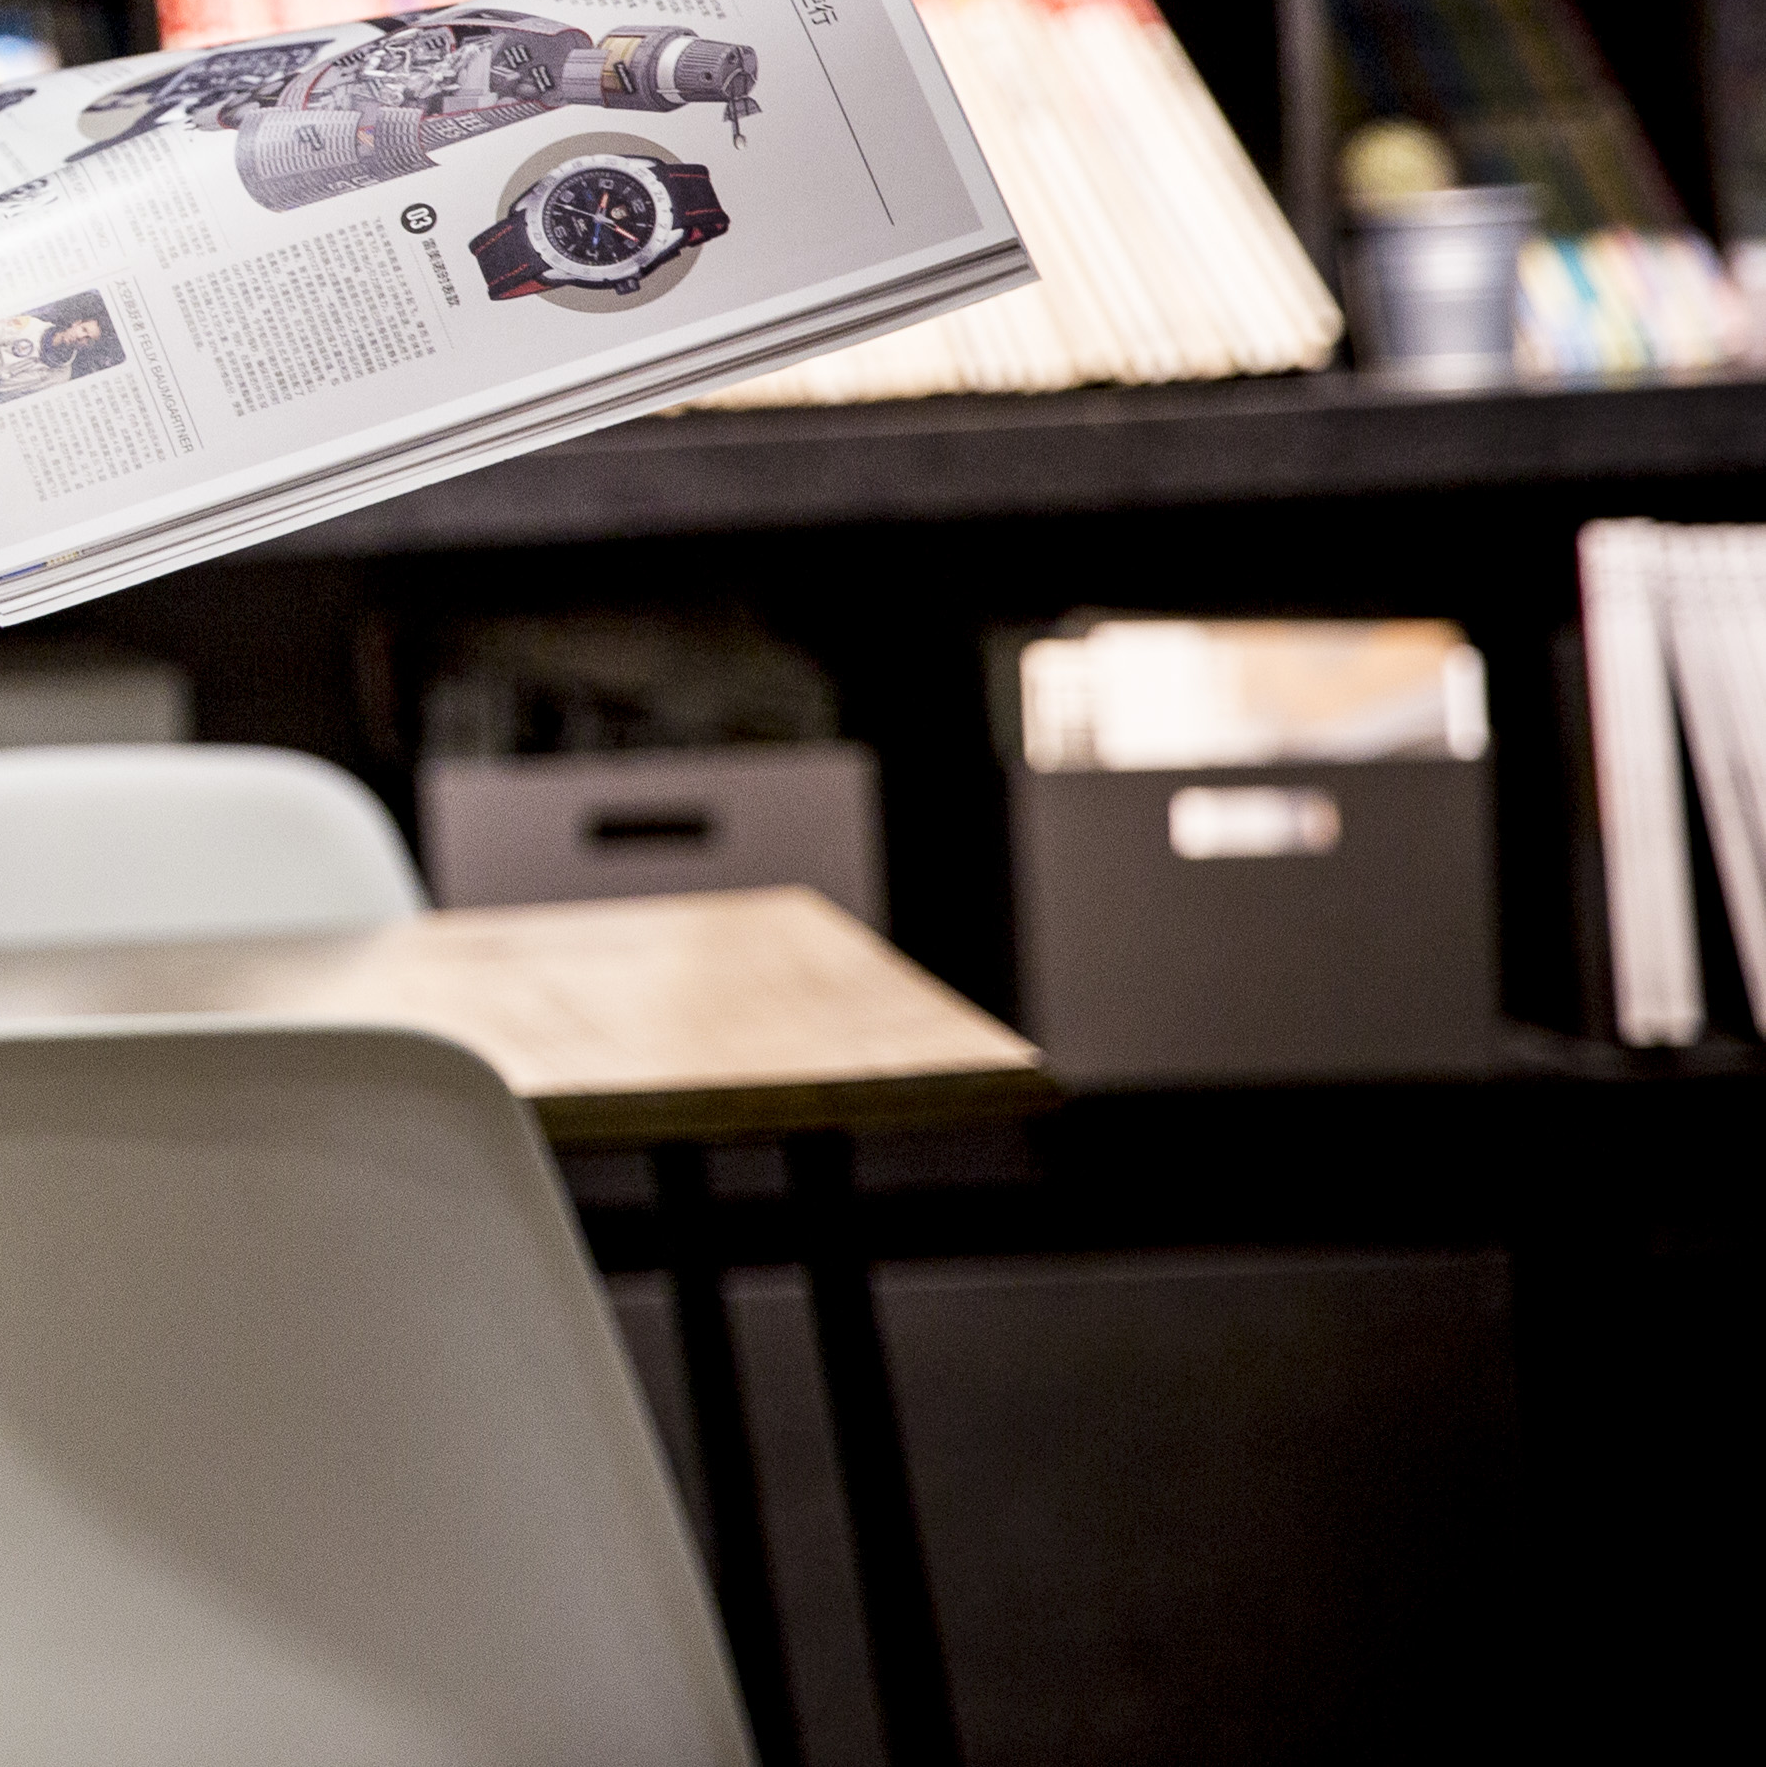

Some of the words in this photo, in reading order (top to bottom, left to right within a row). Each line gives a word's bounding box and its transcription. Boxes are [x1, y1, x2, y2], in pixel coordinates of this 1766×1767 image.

[405, 207, 433, 230] 03
[137, 332, 157, 366] FELIX
[151, 365, 195, 455] BAUMGARTNER
